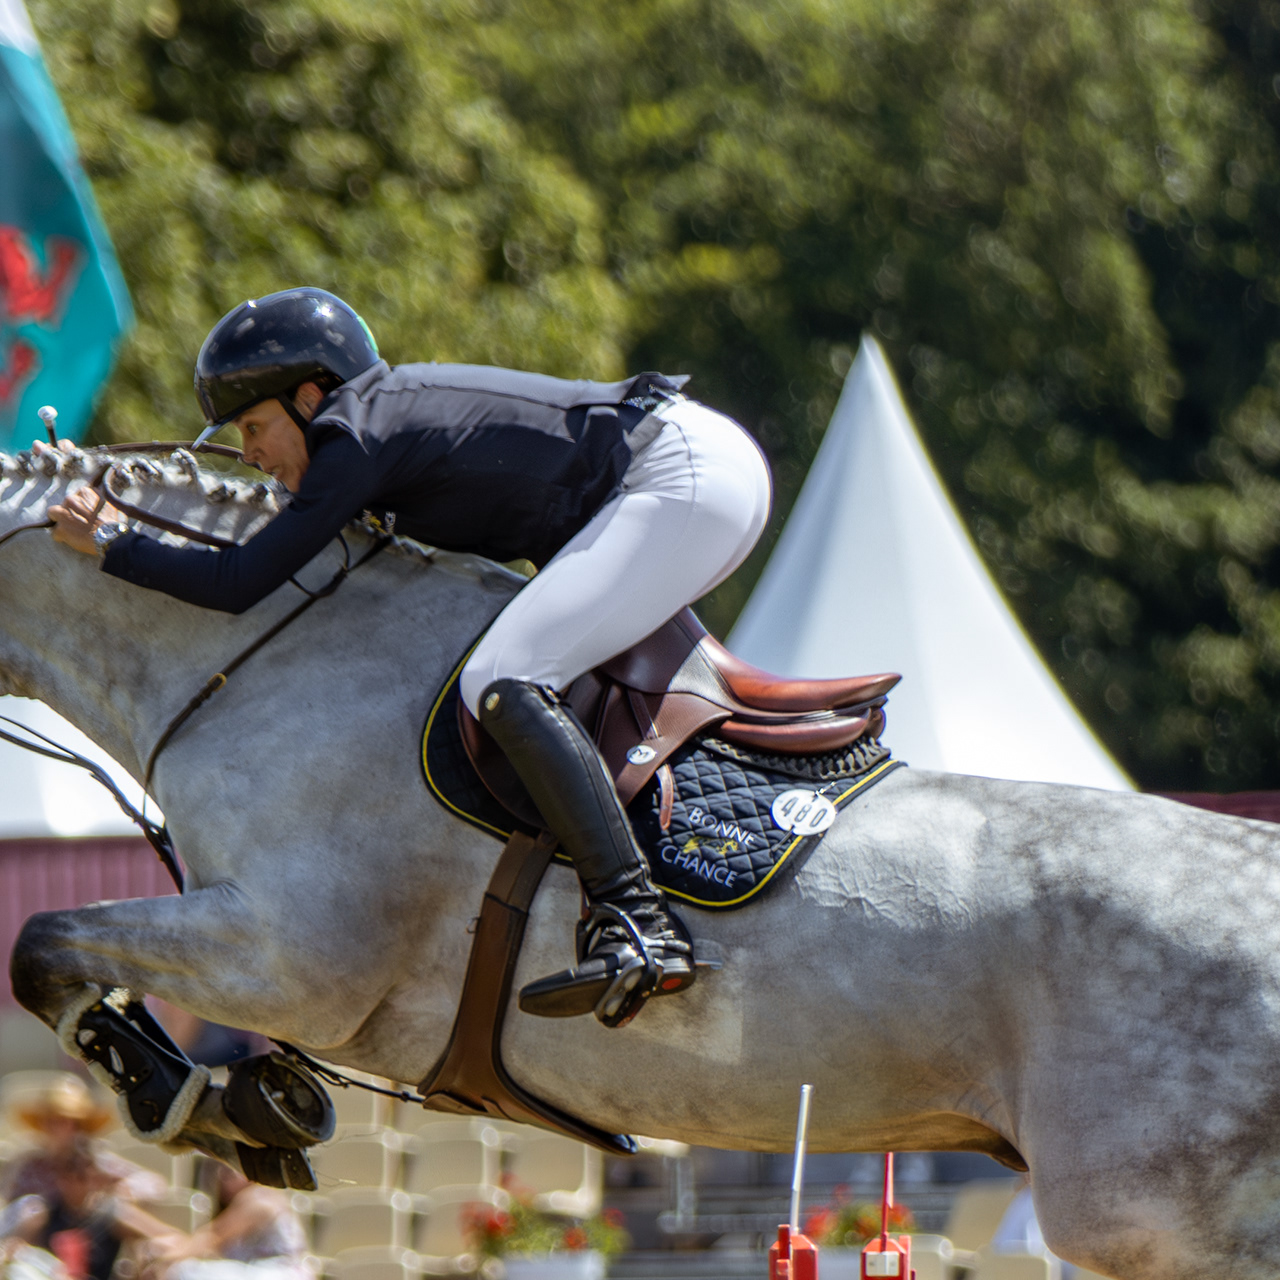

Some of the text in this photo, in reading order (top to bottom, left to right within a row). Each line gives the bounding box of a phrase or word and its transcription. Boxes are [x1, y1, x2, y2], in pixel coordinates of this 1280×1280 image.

[688, 806, 756, 847] BONNE
[780, 796, 829, 828] 480
[661, 844, 739, 888] CHANCE
